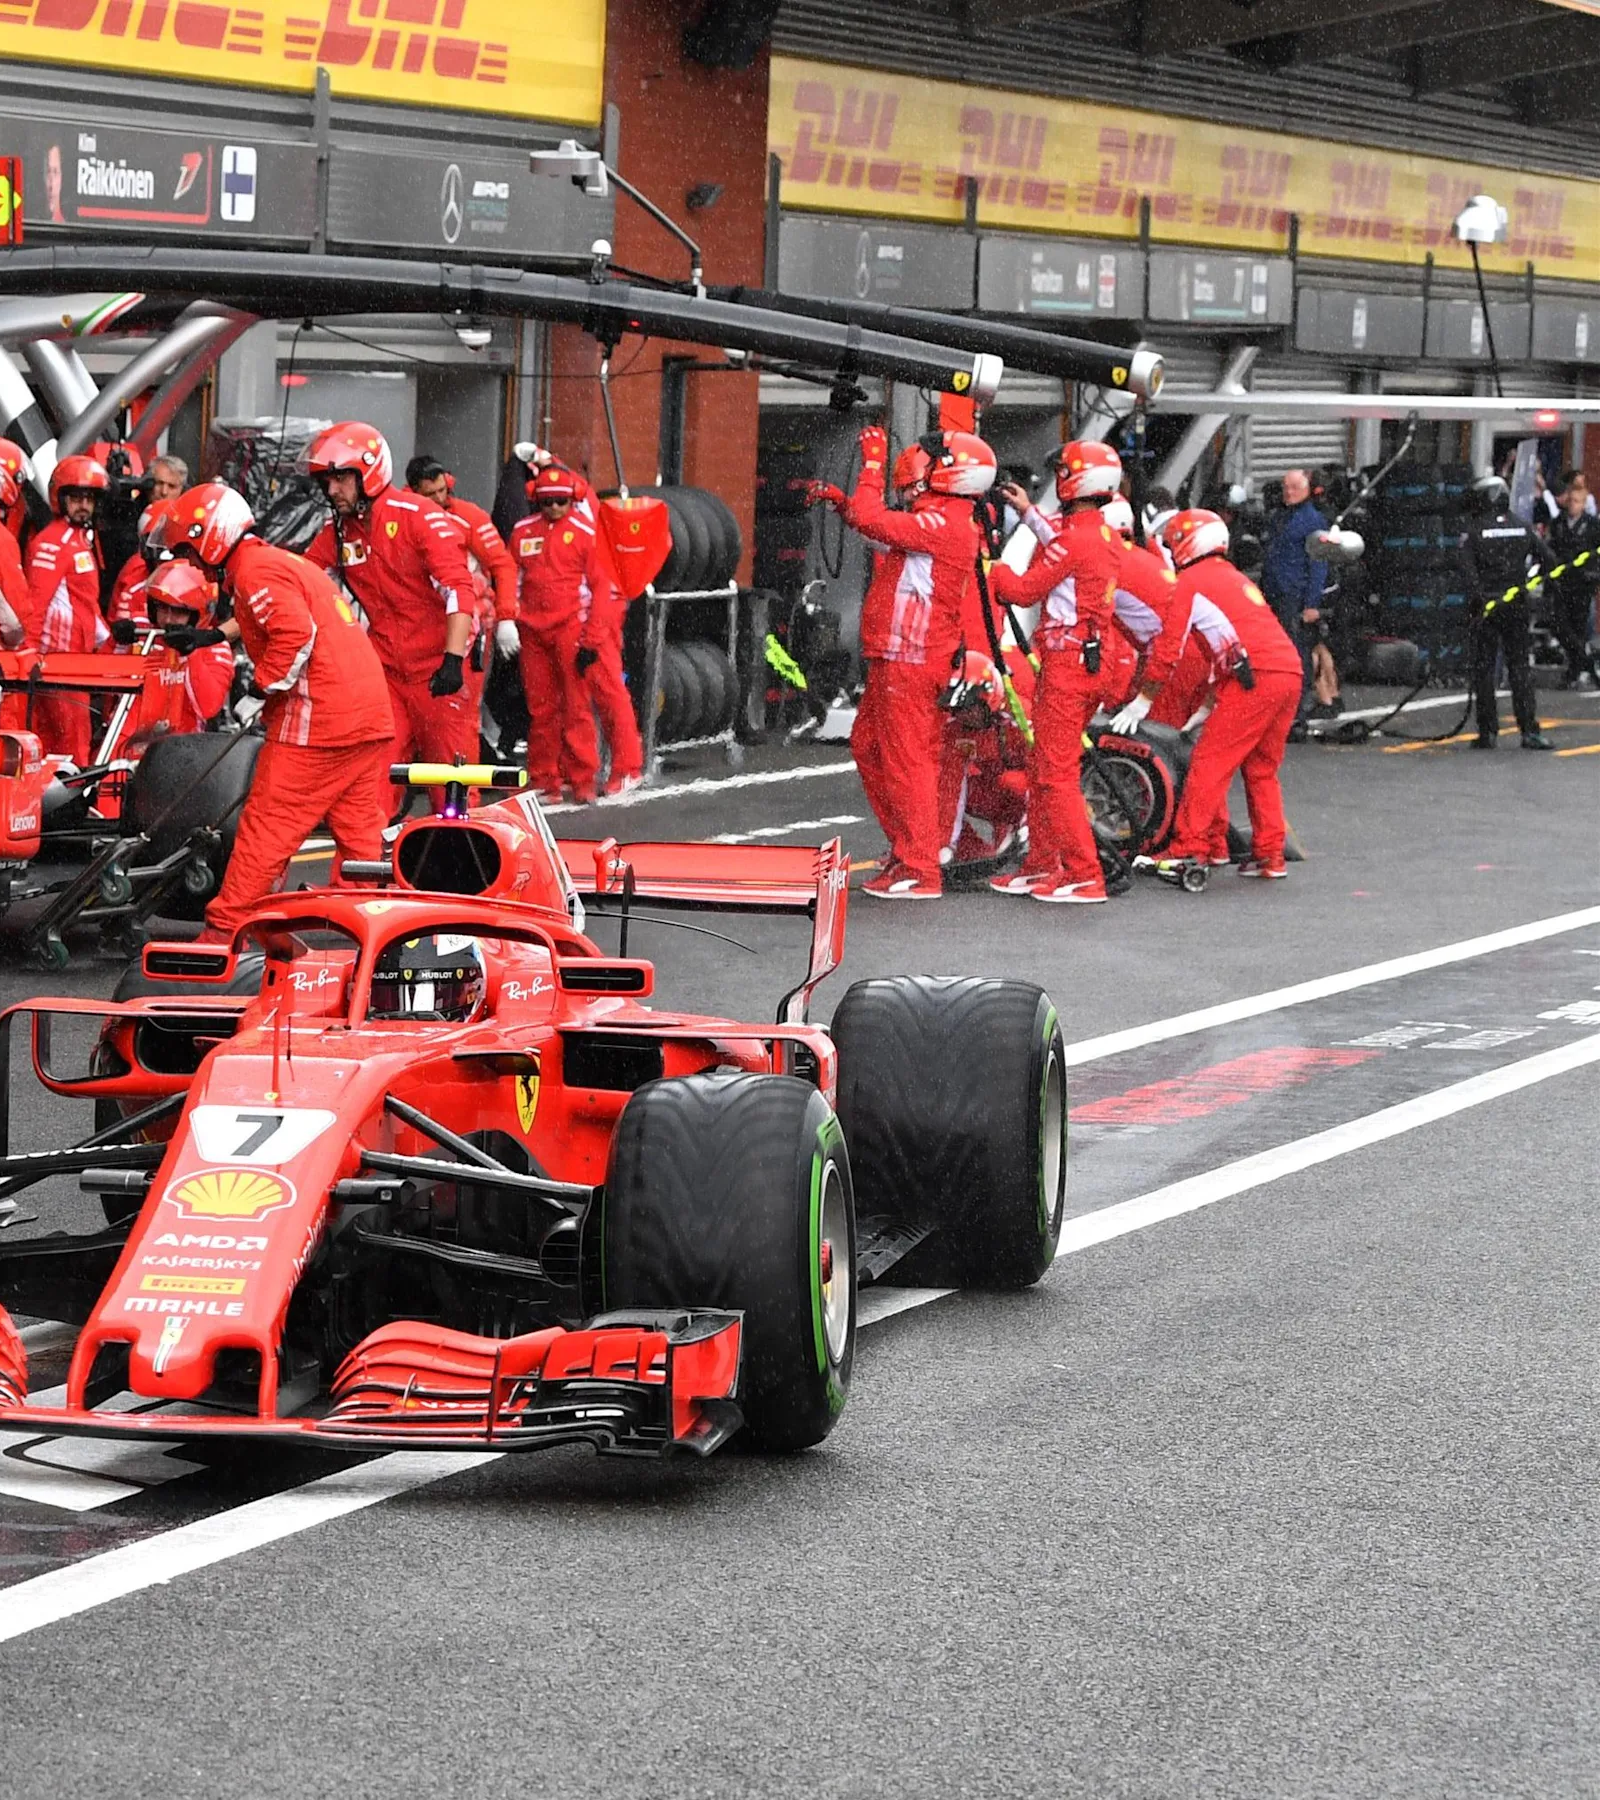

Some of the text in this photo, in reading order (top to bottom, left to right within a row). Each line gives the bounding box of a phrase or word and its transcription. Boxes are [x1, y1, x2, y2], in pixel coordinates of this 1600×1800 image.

[77, 157, 155, 200] Räikkönen
[10, 815, 37, 832] Lenovo
[288, 968, 340, 993] Ray-Ban
[421, 971, 453, 980] HUBLOT
[501, 977, 554, 1001] Ray-Ban
[231, 1114, 285, 1157] 7
[124, 1297, 245, 1316] MAHLE
